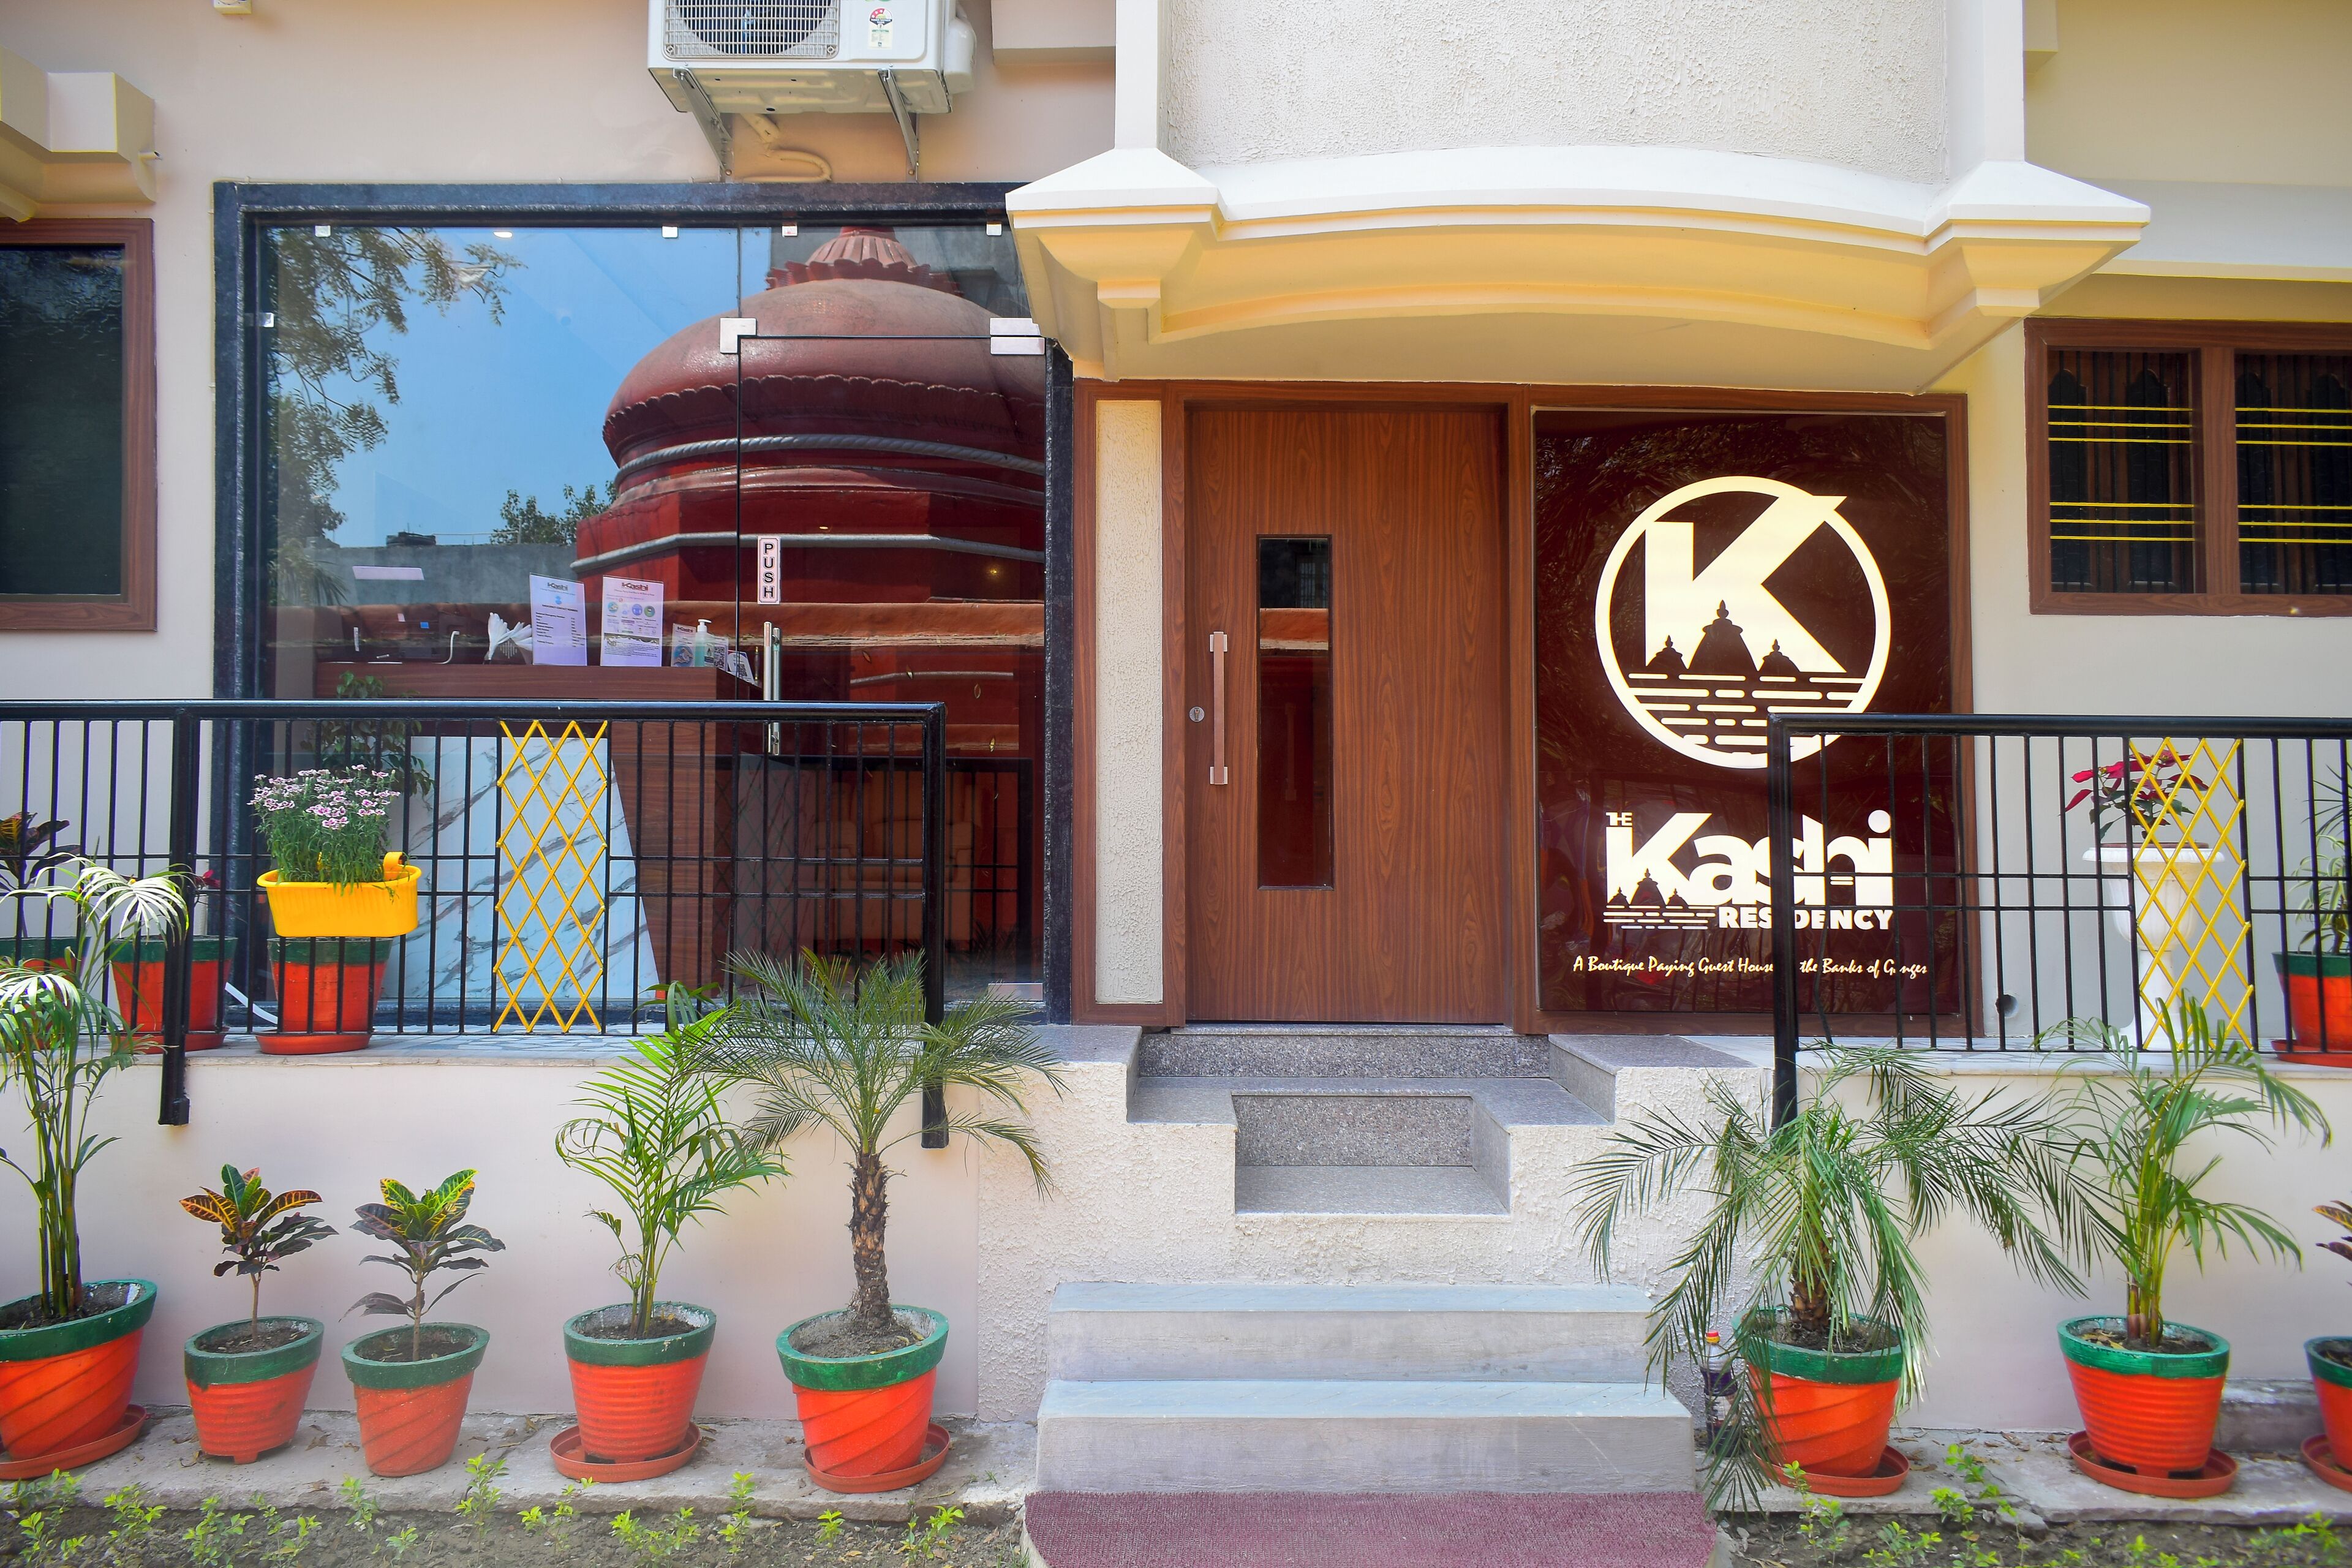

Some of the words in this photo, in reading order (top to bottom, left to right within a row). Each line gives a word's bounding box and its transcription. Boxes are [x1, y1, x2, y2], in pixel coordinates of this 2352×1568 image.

[763, 543, 775, 598] PUSH
[621, 582, 649, 592] Kashi
[1605, 809, 1894, 907] Kashi
[1719, 907, 1894, 930] RESDENCY
[1573, 955, 1584, 972] A
[1588, 956, 1645, 976] Boutique
[1648, 956, 1695, 978] Paying
[1698, 957, 1734, 972] Guest
[1799, 957, 1819, 973] the
[1822, 958, 1863, 974] Banks
[1866, 959, 1880, 979] of
